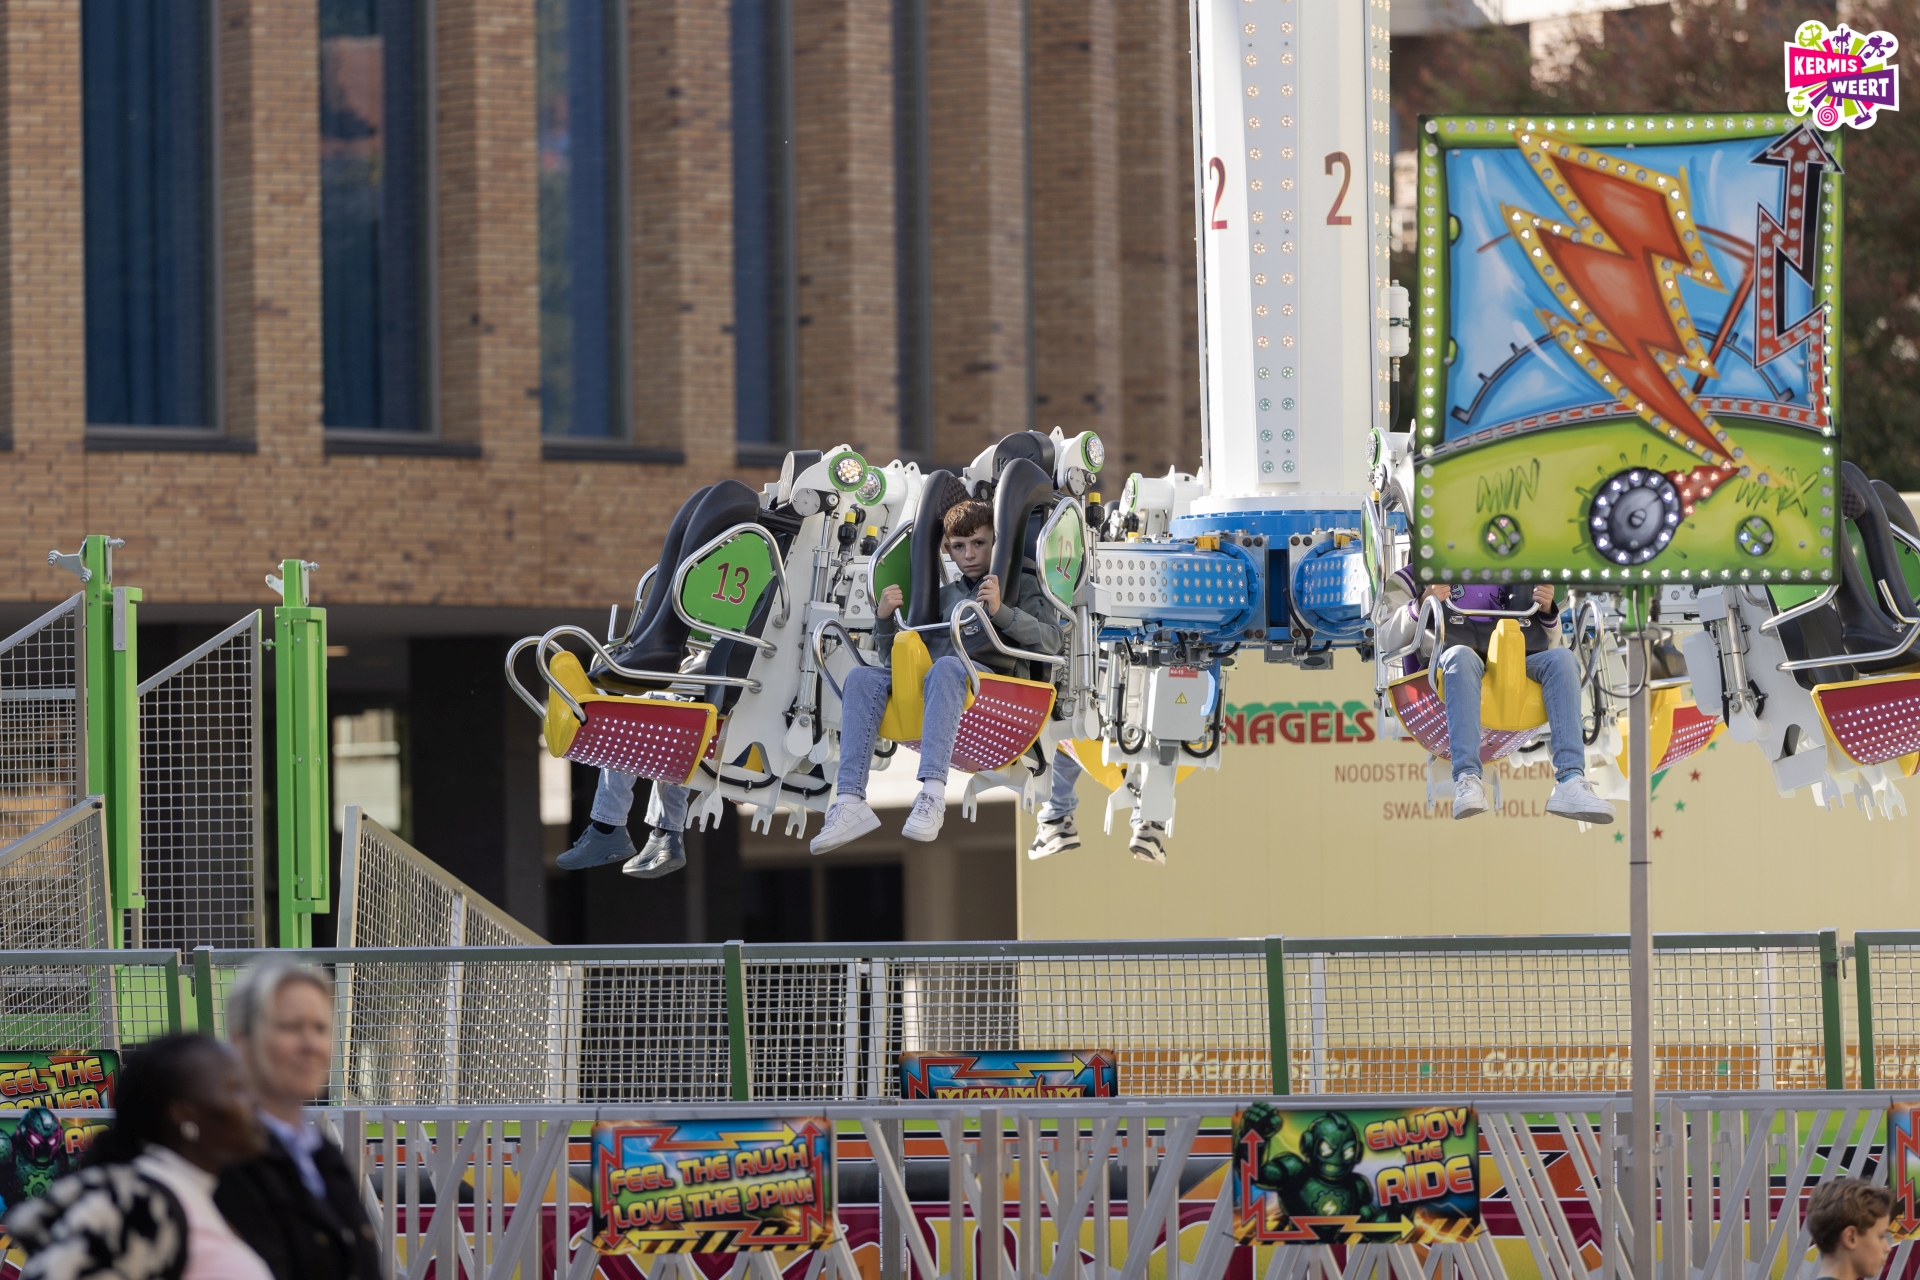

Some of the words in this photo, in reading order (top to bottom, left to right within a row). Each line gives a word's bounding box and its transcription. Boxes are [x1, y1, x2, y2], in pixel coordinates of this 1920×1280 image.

[1209, 156, 1228, 231] 2
[1323, 151, 1353, 226] 2
[1056, 534, 1072, 582] 12
[711, 562, 750, 605] 13
[1383, 800, 1456, 821] SWALM
[50, 1057, 104, 1088] THE
[1365, 1107, 1467, 1150] ENJOY
[609, 1163, 675, 1195] FEEL
[676, 1154, 731, 1185] THE
[734, 1143, 809, 1177] RUSH
[1401, 1140, 1443, 1164] THE
[1376, 1155, 1475, 1207] RIDE
[612, 1196, 685, 1229] LOVE
[686, 1187, 741, 1218] THE
